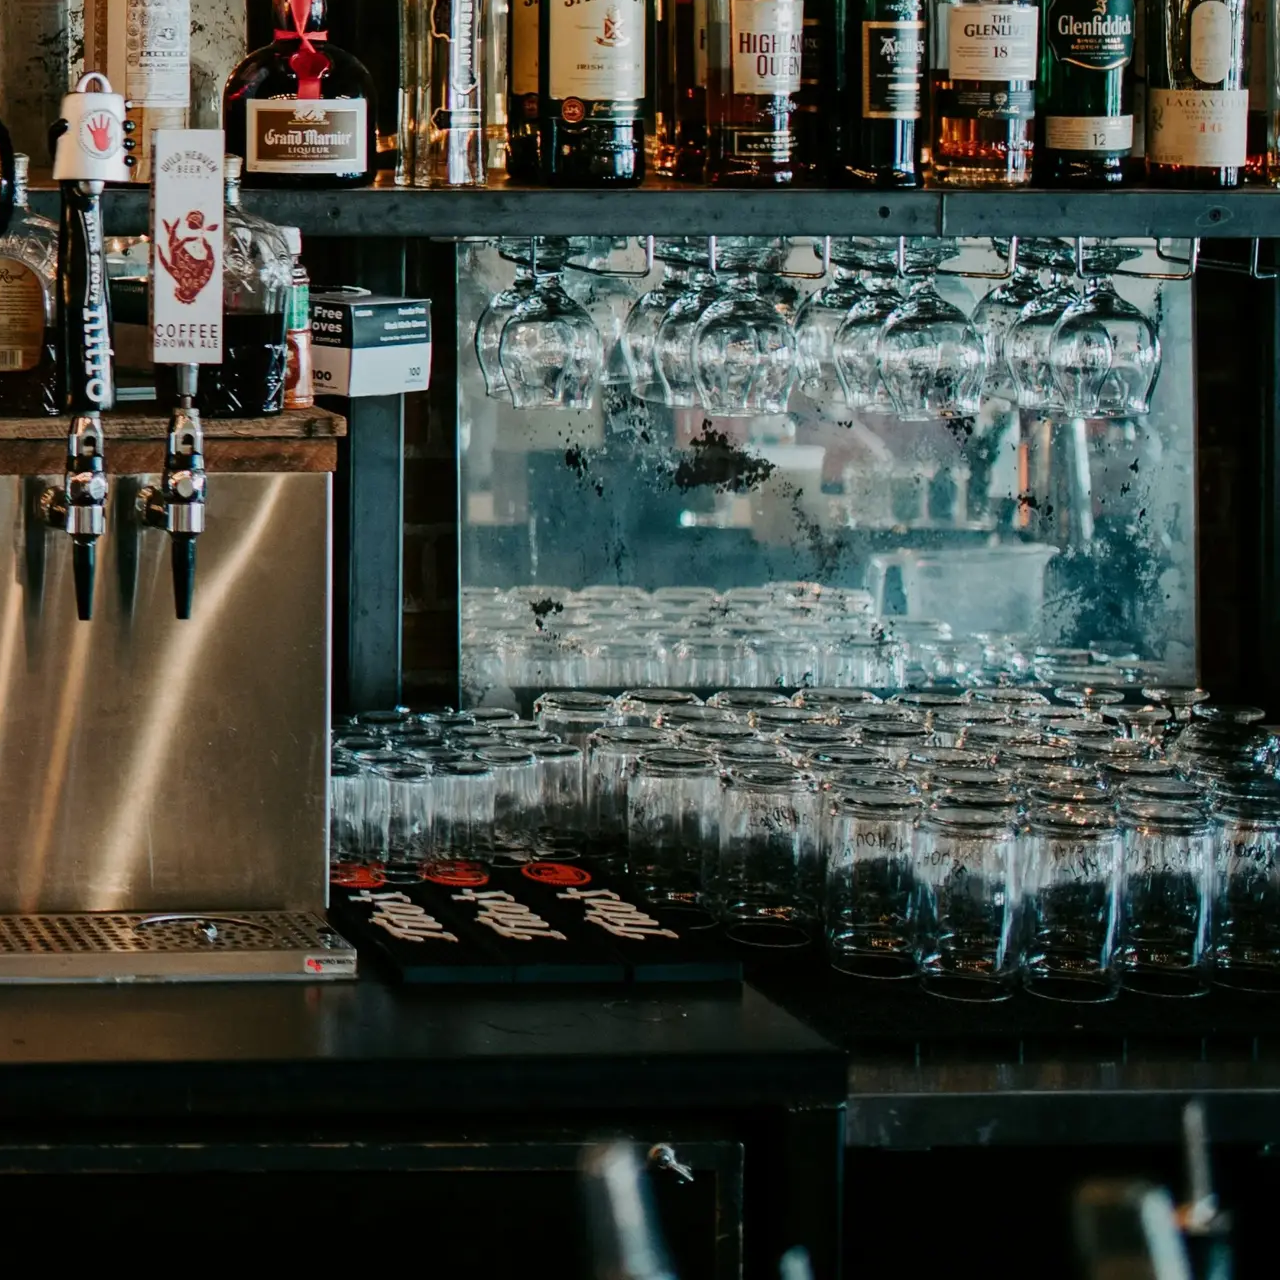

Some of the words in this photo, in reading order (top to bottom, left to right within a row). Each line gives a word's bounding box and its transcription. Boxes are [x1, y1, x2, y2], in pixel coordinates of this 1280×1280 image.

[992, 14, 1013, 24] THE
[1057, 14, 1132, 36] Glenfiddich
[992, 45, 1009, 59] 18
[576, 63, 604, 71] IRISH
[756, 54, 800, 78] QUEEN
[264, 129, 302, 146] Grand
[302, 129, 353, 147] Marnier
[1091, 132, 1107, 146] 12
[287, 146, 330, 154] LIQUEUR
[160, 152, 183, 174] WILD
[184, 150, 220, 174] HEAVEN
[176, 164, 202, 174] BEER
[313, 306, 343, 320] Free
[155, 323, 219, 339] COFFEE
[155, 338, 197, 349] BROWN
[200, 338, 219, 349] ALE
[315, 336, 342, 344] contact
[312, 369, 333, 381] 100
[408, 366, 422, 376] 100
